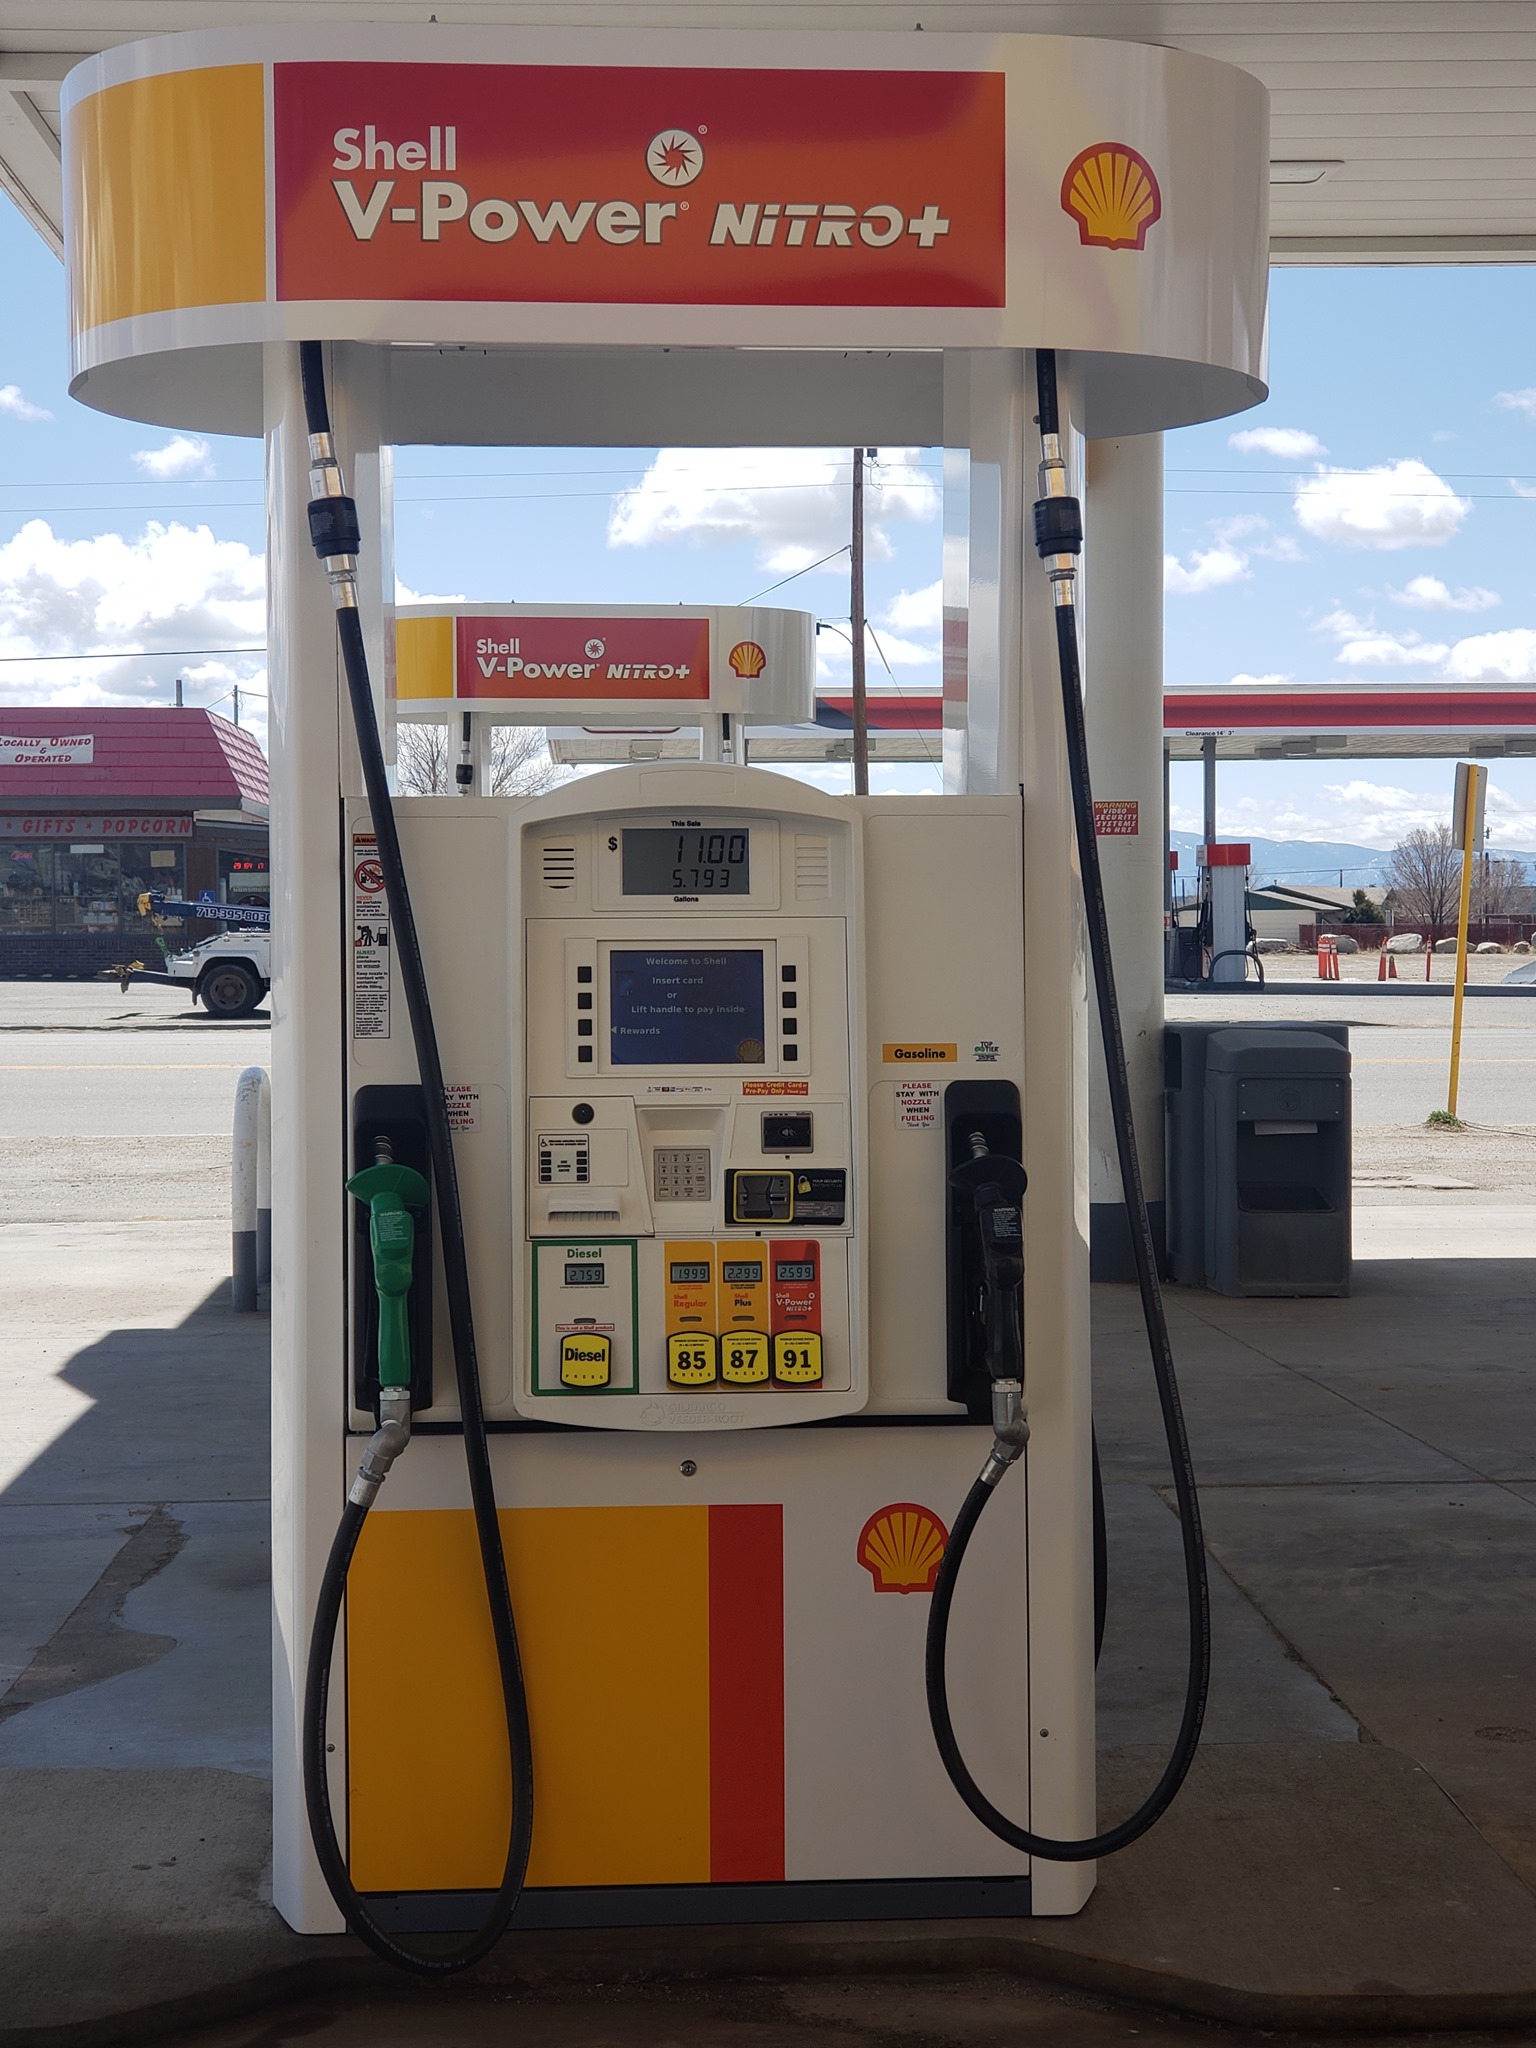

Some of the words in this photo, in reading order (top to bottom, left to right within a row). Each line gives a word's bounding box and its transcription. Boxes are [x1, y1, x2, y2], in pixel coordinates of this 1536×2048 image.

[332, 125, 457, 171] Shell
[332, 180, 677, 244] V-Power
[476, 638, 520, 654] Shell
[476, 657, 596, 679] V-Power
[22, 819, 76, 833] GIFTS
[102, 819, 191, 834] POPCORN
[608, 836, 618, 852] $
[677, 835, 746, 864] 11.00
[672, 869, 729, 888] 5.793
[703, 957, 727, 965] Shell
[697, 1007, 714, 1015] pay
[717, 1005, 745, 1013] inside
[620, 1027, 661, 1035] Rewards
[894, 1048, 946, 1059] Gasoline
[567, 1248, 602, 1258] Diesel
[570, 1270, 601, 1280] 2.759
[677, 1268, 706, 1279] 1.999
[728, 1268, 759, 1279] 2.299
[780, 1267, 811, 1278] 2.599
[674, 1300, 708, 1309] Regular
[565, 1348, 605, 1362] Diesel
[677, 1351, 706, 1370] 85
[730, 1350, 759, 1369] 87
[783, 1349, 811, 1368] 91
